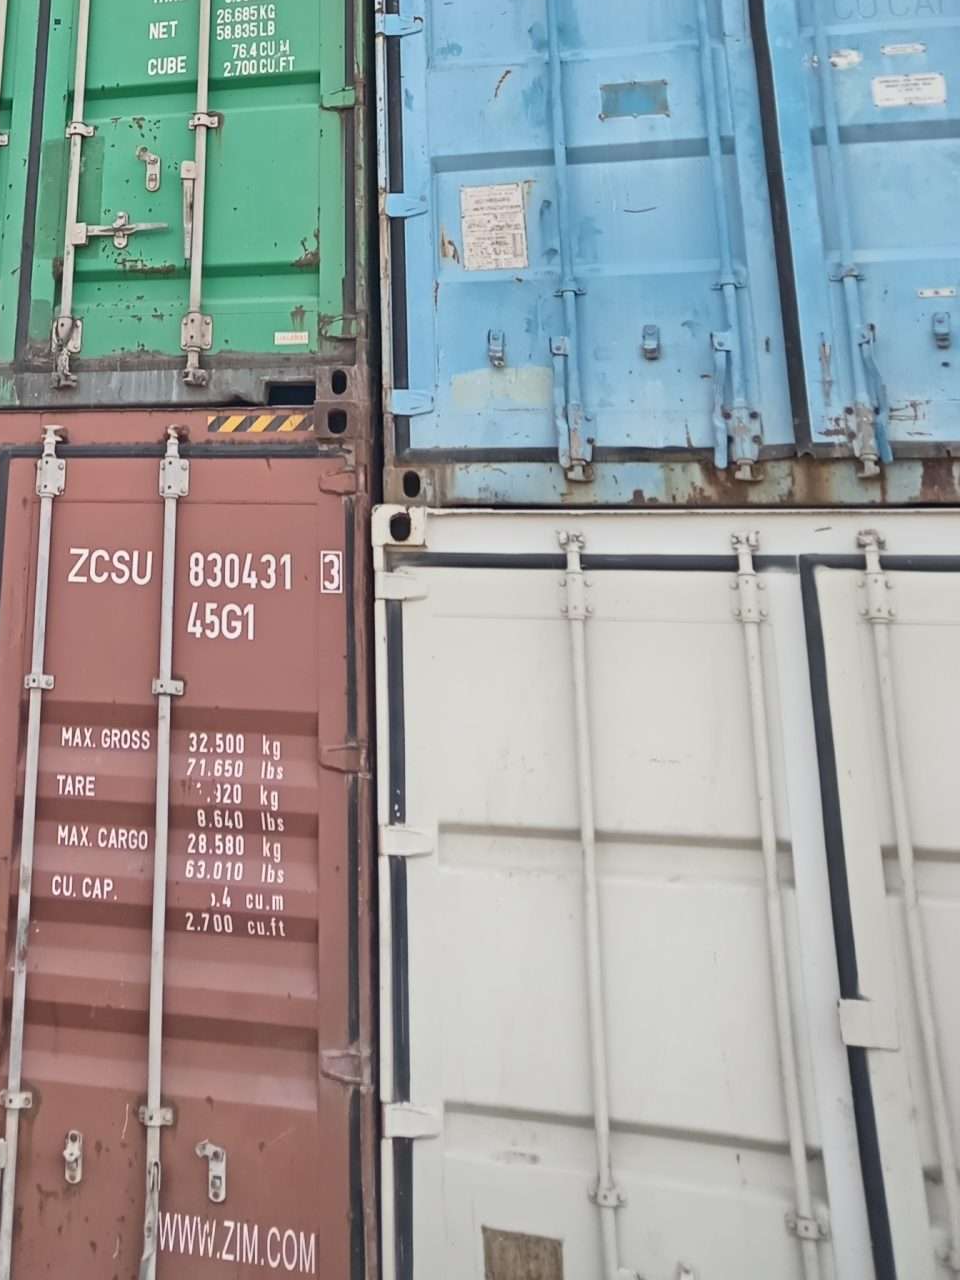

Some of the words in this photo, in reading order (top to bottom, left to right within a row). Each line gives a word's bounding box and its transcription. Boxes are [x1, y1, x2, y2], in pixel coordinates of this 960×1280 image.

[149, 20, 178, 40] NET
[216, 5, 258, 25] 26.685
[259, 4, 276, 19] KG
[216, 22, 257, 40] 58.835
[259, 20, 275, 36] LB
[147, 56, 187, 76] CUBE
[231, 42, 257, 60] 76.4
[223, 60, 257, 77] 2.700
[259, 56, 296, 74] CU.FT
[68, 548, 153, 586] ZCSU
[188, 552, 293, 589] 830431
[322, 552, 341, 592] 3
[187, 602, 256, 640] 45G1
[61, 727, 96, 748] MAX.
[101, 729, 151, 750] GROSS
[188, 732, 245, 754] 32.500
[262, 735, 281, 761] kg
[186, 758, 243, 778] 71.650
[261, 761, 284, 780] lbs
[56, 775, 96, 796] TARE
[260, 785, 279, 811] kg
[197, 809, 243, 830] 8.640
[261, 812, 285, 833] lbs
[57, 825, 93, 847] MAX.
[97, 827, 149, 850] CARGO
[187, 833, 245, 856] 28.580
[262, 838, 281, 864] kg
[185, 860, 243, 881] 63.010
[261, 863, 284, 884] lbs
[51, 875, 76, 897] CU.
[82, 877, 118, 900] CAP.
[245, 892, 284, 911] cu.m
[185, 912, 233, 934] 2.700
[247, 918, 286, 937] cu.ft
[158, 1210, 316, 1275] WWW.ZIM.COM
